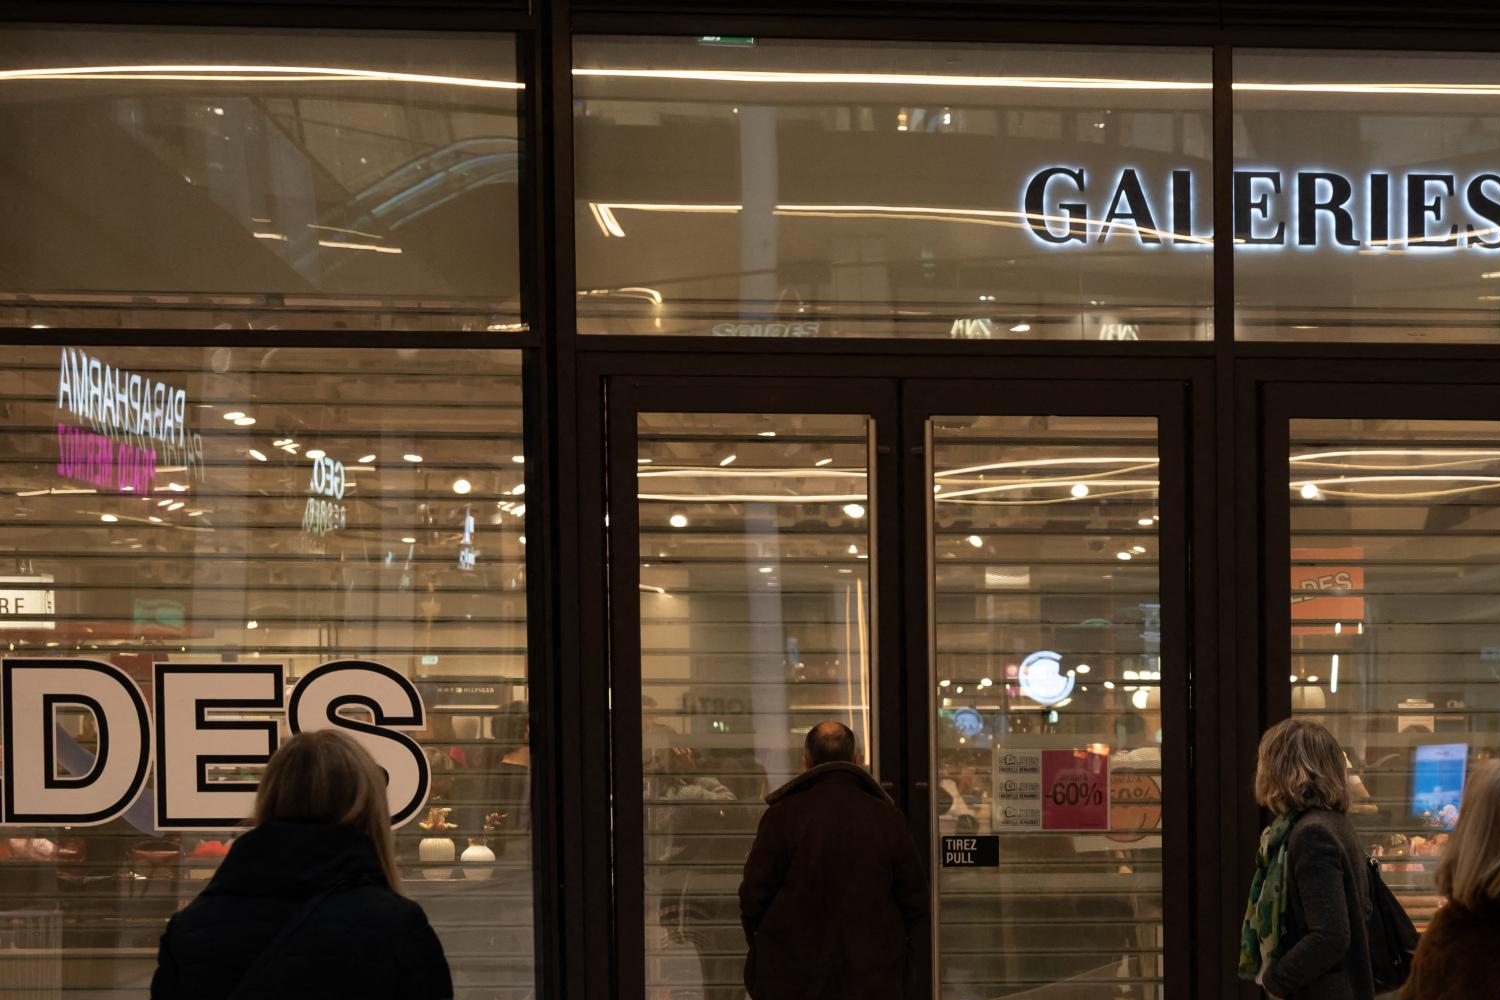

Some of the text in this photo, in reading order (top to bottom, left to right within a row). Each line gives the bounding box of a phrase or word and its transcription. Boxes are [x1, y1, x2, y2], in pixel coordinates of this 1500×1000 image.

[0, 657, 432, 831] DES
[1046, 783, 1103, 806] -60%
[946, 839, 977, 852] TIREZ
[946, 852, 974, 865] PULL
